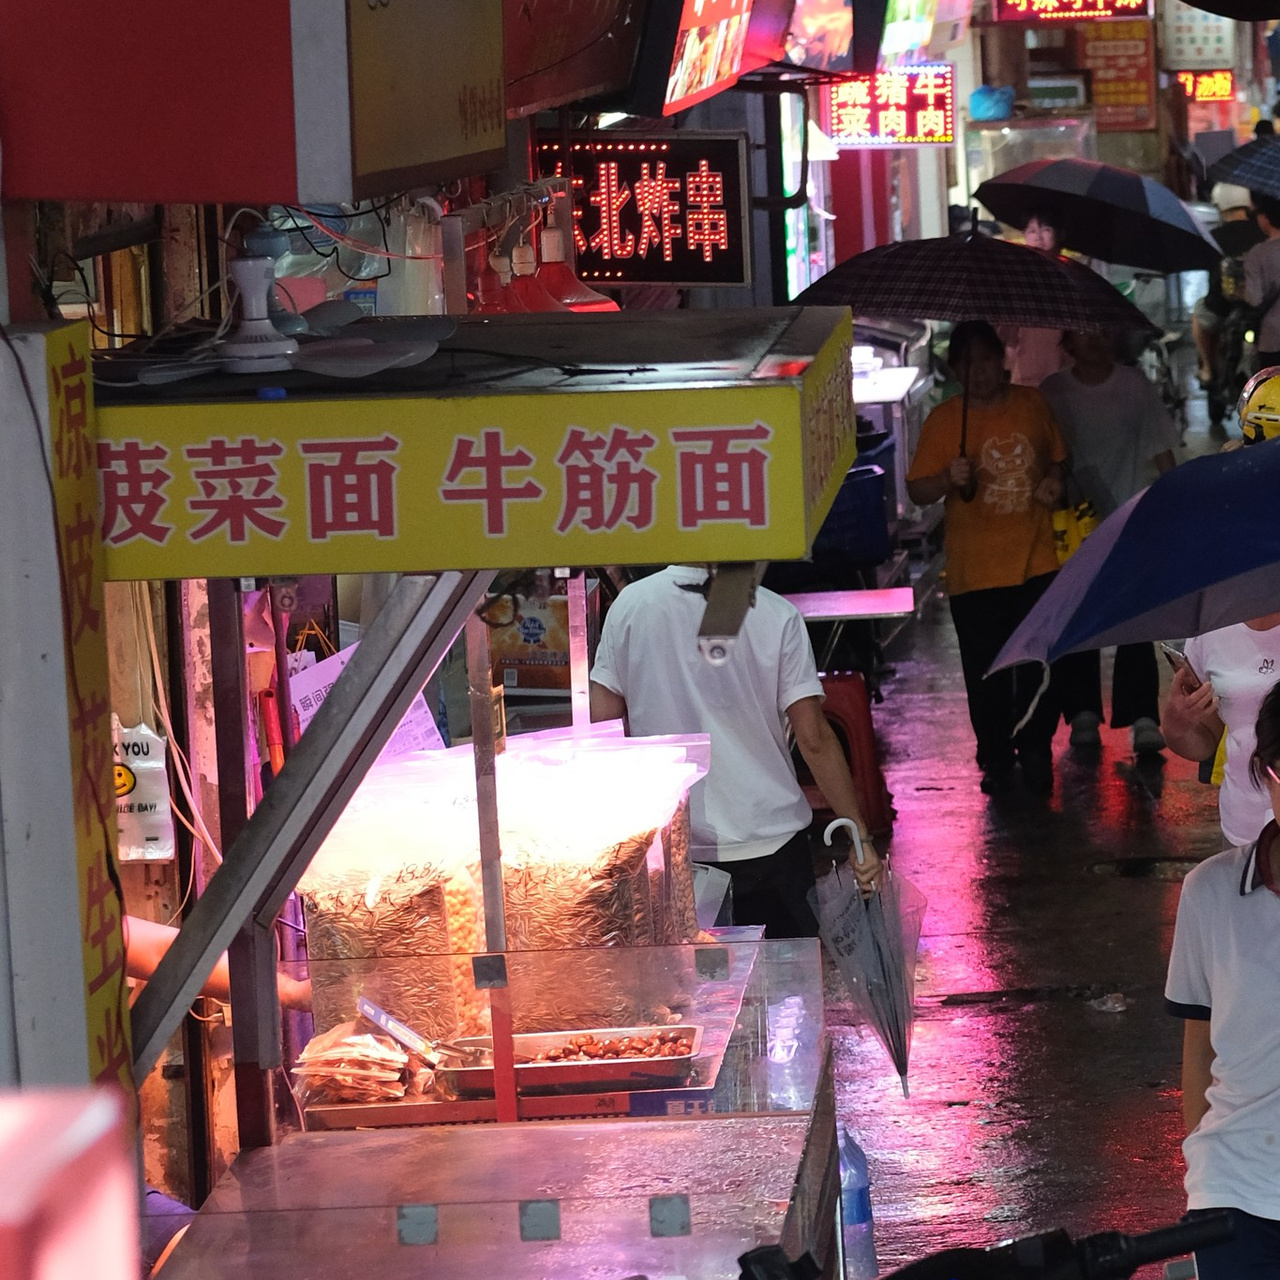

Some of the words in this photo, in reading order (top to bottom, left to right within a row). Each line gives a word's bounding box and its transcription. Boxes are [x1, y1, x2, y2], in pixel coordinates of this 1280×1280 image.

[441, 422, 773, 538] 牛筋面
[122, 741, 150, 756] YOU
